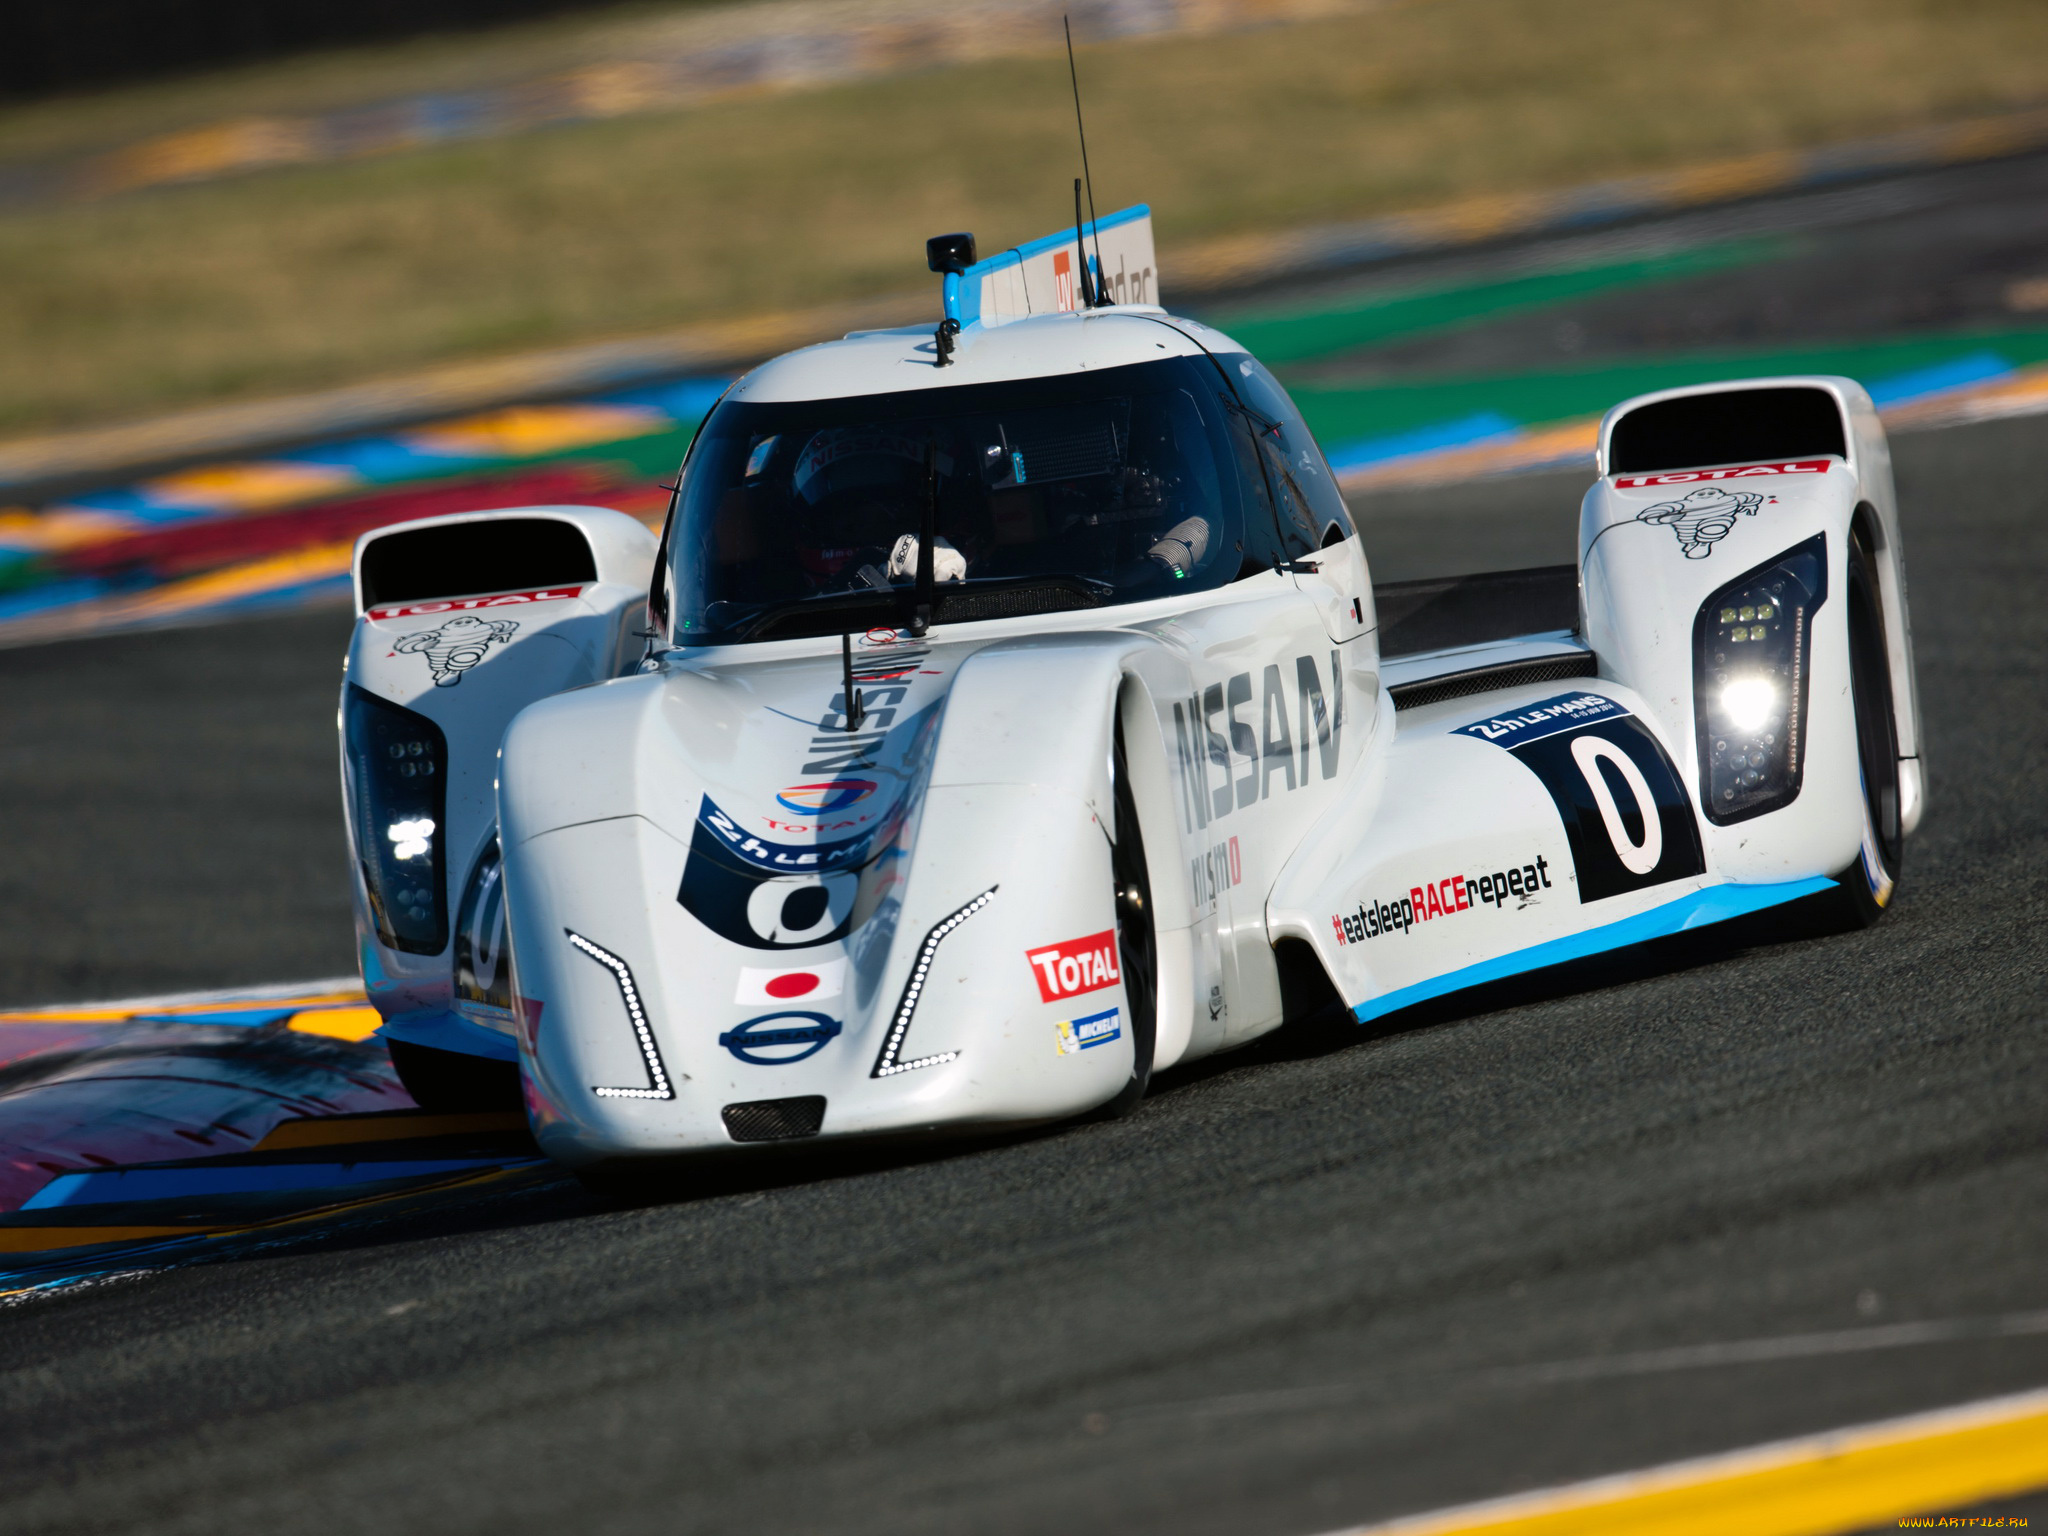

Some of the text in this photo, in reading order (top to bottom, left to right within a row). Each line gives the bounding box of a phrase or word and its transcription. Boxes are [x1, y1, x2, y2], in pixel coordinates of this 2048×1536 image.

[810, 435, 917, 473] NISSAN
[1621, 463, 1818, 487] TOTAL
[373, 591, 569, 617] TOTAL
[801, 649, 933, 775] NISSAN
[1468, 694, 1607, 740] 24h LE MANS
[1173, 649, 1344, 835] NISSAN
[761, 812, 877, 834] TOTAL
[1570, 735, 1664, 875] 0
[774, 852, 819, 865] LE
[1191, 834, 1242, 909] nismo
[746, 869, 860, 945] 0
[1332, 855, 1552, 946] #eatsleepRACErepeat
[1031, 946, 1119, 995] TOTAL
[730, 1024, 832, 1046] NISSAN
[1078, 1014, 1119, 1037] MICHELIN
